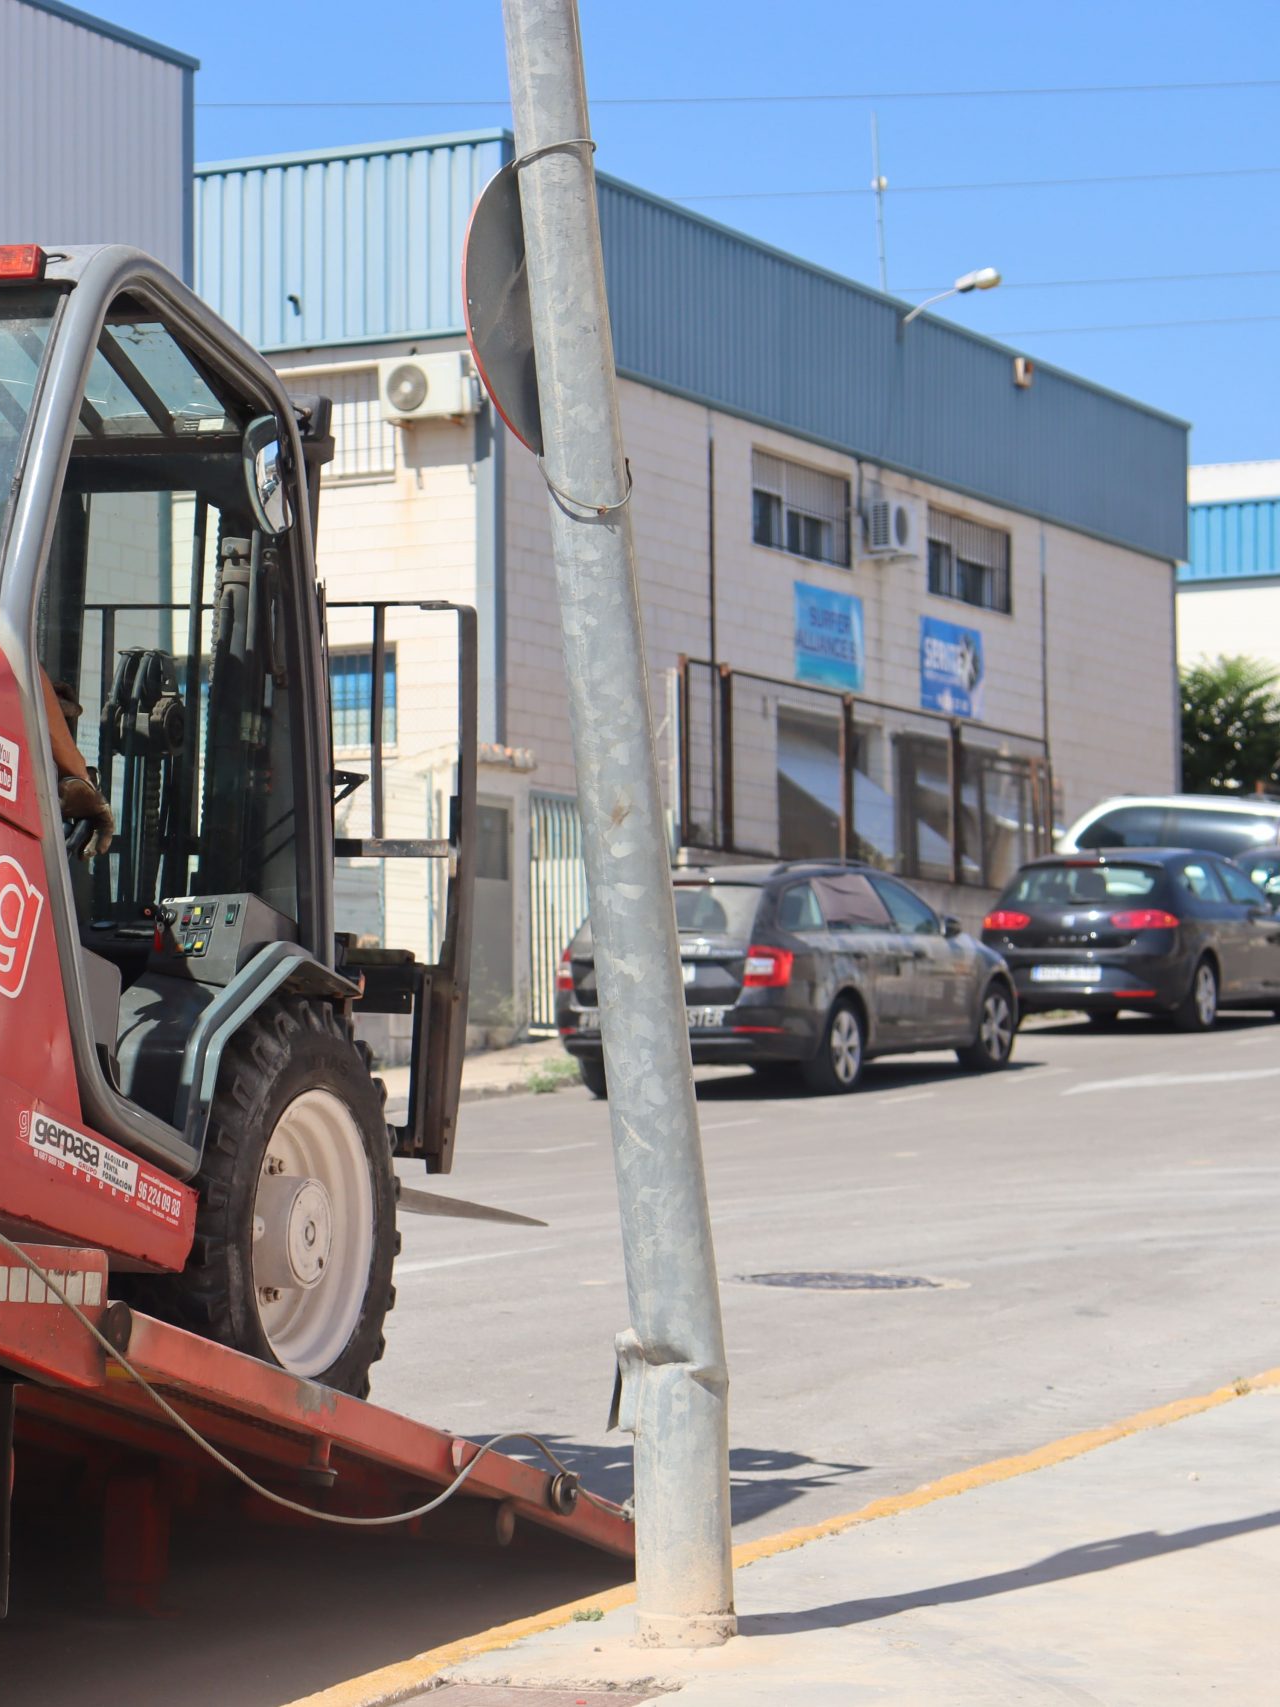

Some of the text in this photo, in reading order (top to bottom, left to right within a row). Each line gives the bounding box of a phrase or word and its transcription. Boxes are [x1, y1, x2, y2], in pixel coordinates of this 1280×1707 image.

[0, 743, 11, 764] You
[34, 1118, 100, 1168] gerpasa
[77, 1162, 97, 1175] GRUPO
[103, 1161, 119, 1175] VENTA
[104, 1152, 129, 1170] ALQUILER
[137, 1180, 148, 1201] 96
[147, 1186, 161, 1208] 224
[161, 1193, 171, 1213] 09
